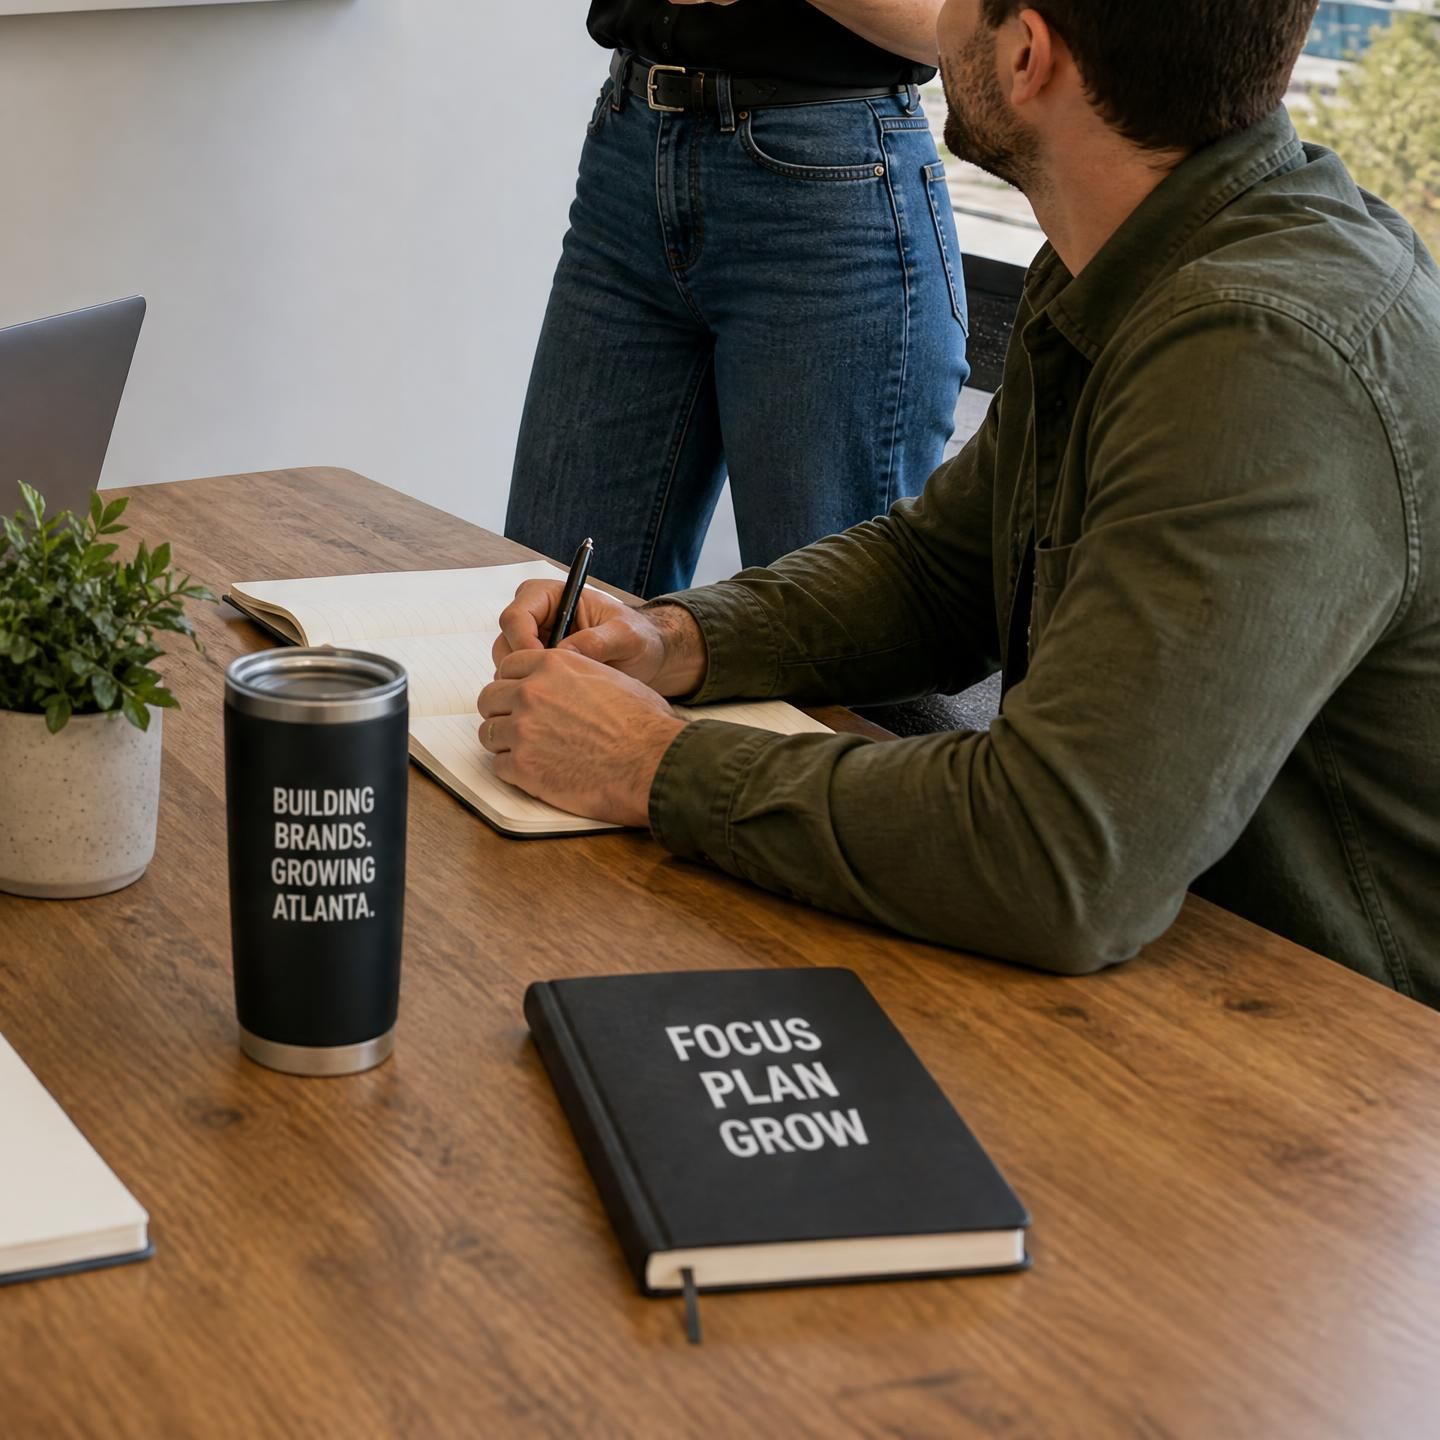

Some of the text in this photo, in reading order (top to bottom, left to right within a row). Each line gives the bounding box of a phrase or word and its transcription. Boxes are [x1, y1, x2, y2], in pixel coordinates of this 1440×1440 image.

[274, 787, 374, 815] BUILDING
[276, 822, 371, 850] BRANDS.
[272, 856, 375, 886] GROWING
[273, 893, 374, 921] ATLANTA.
[666, 1018, 821, 1060] FOCUS
[700, 1063, 839, 1108] PLAN
[720, 1109, 868, 1157] GROW
